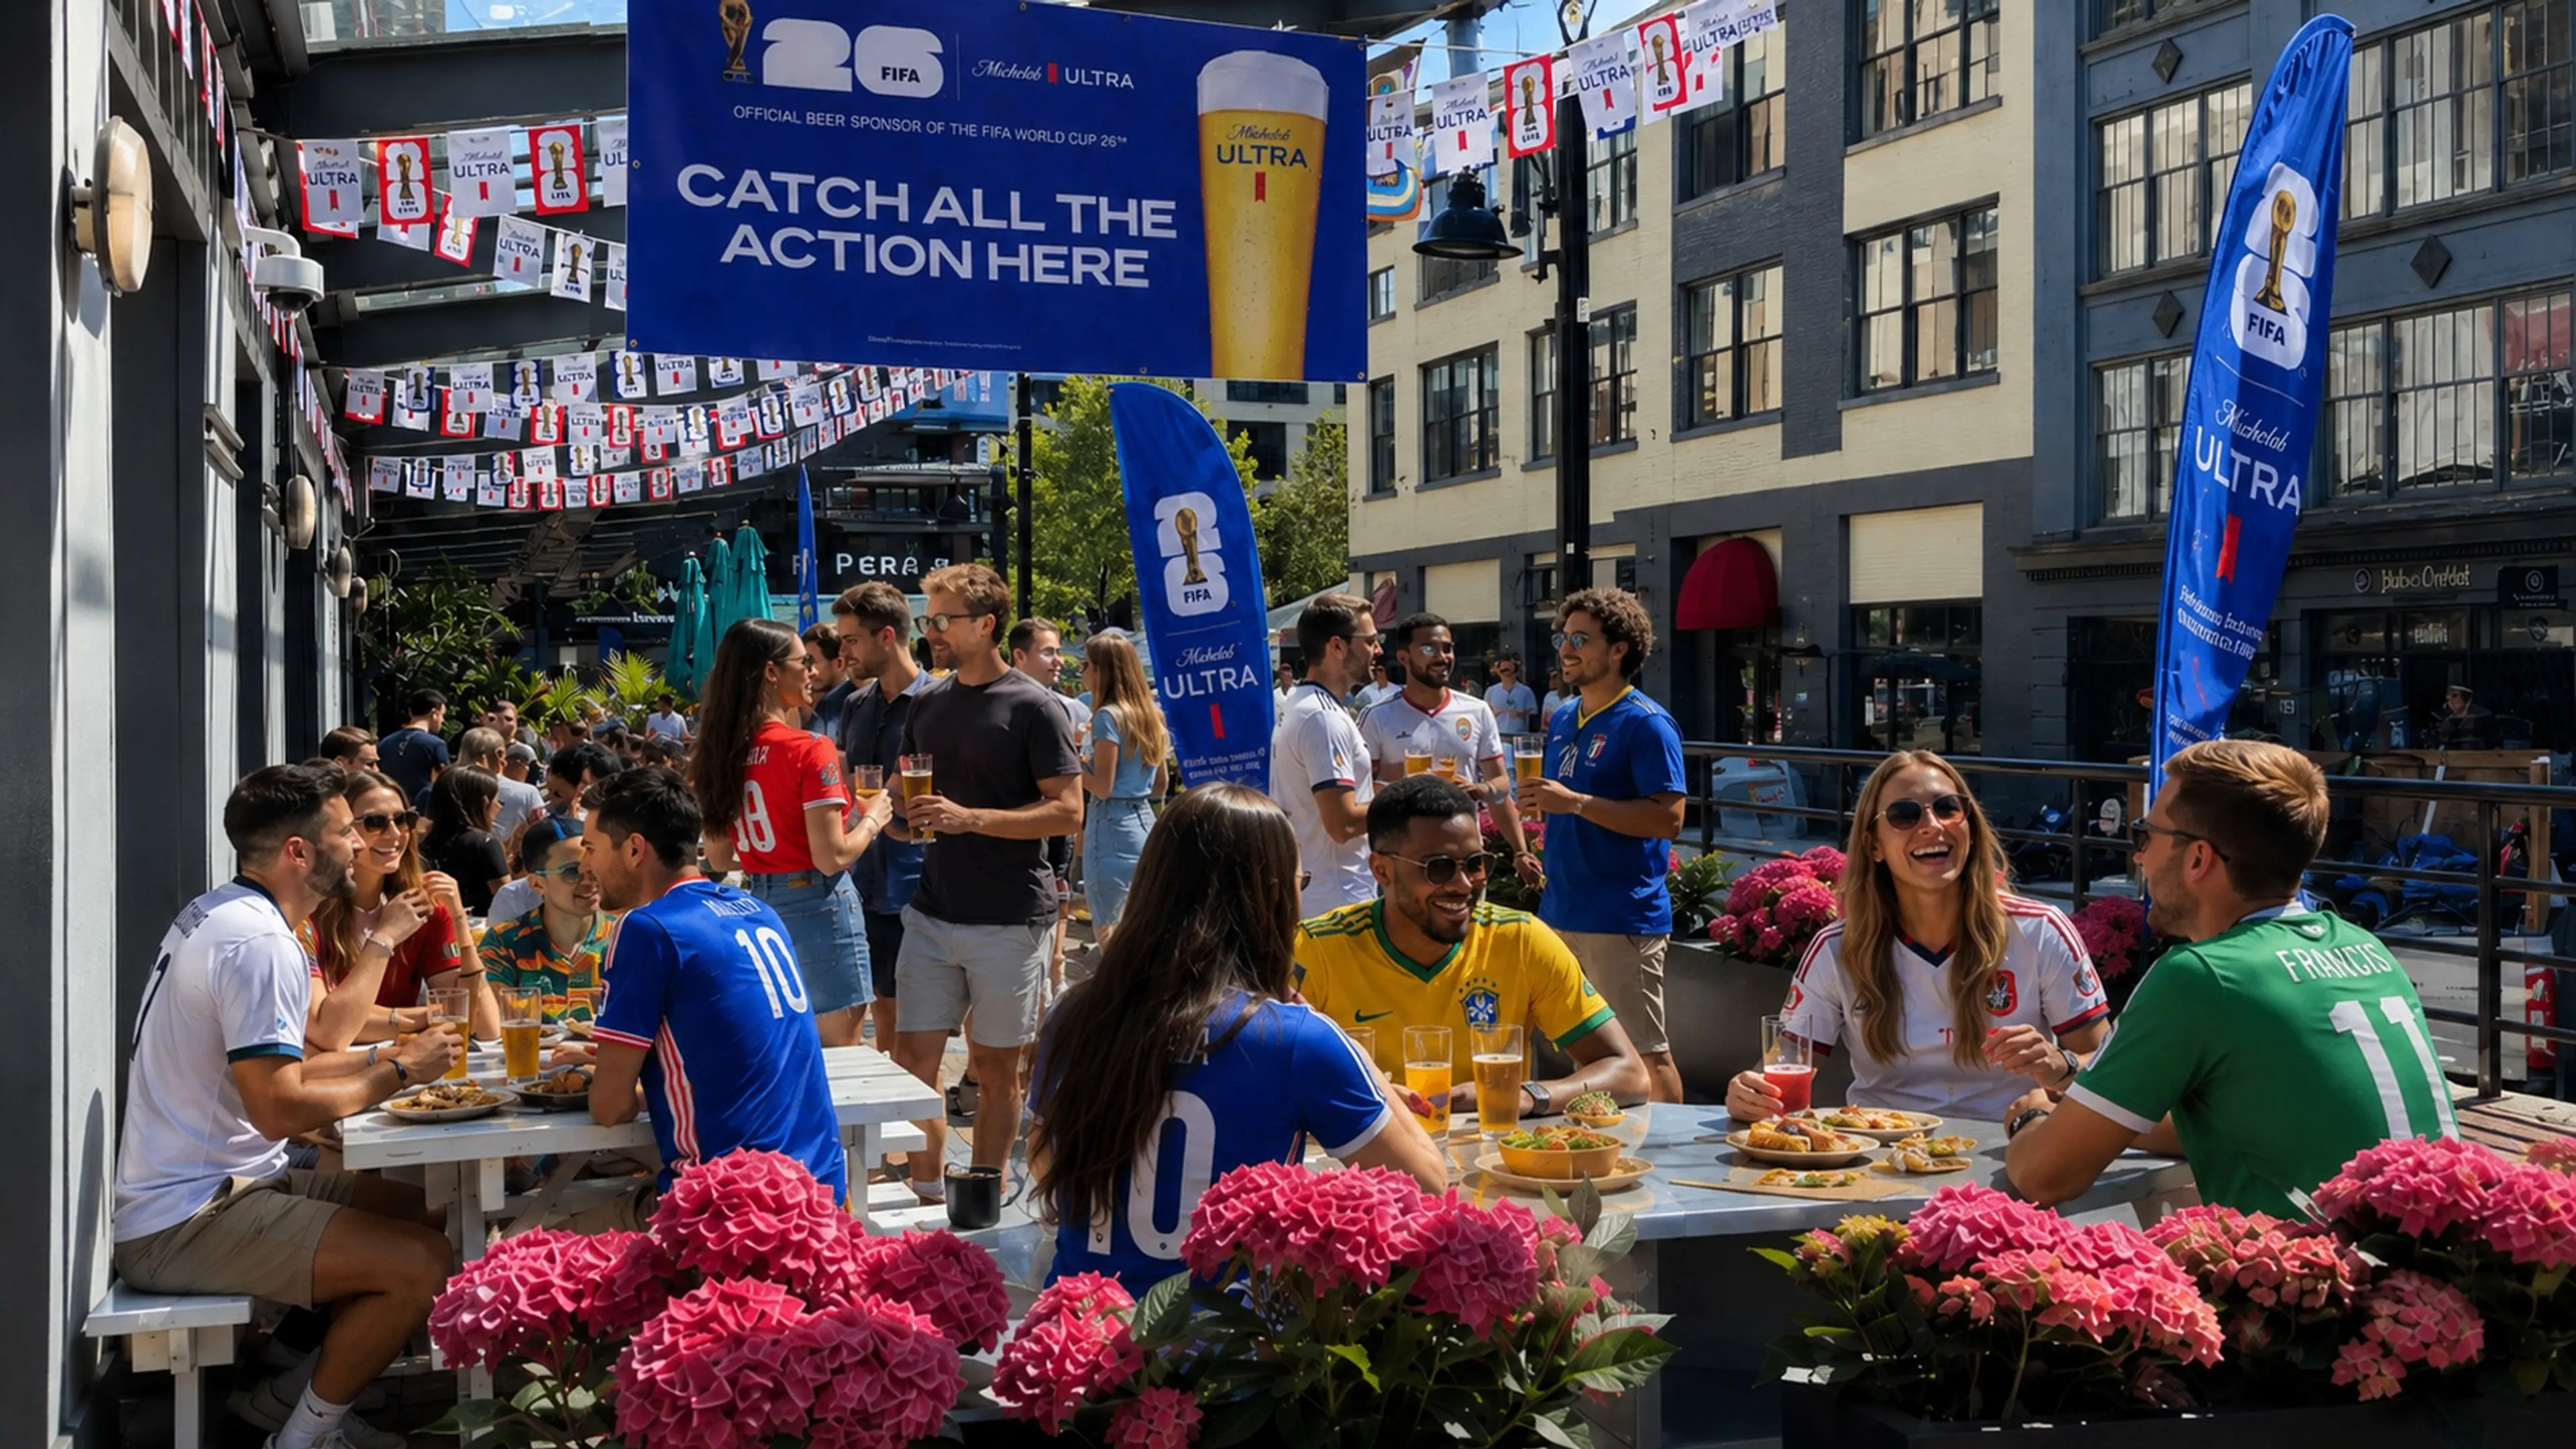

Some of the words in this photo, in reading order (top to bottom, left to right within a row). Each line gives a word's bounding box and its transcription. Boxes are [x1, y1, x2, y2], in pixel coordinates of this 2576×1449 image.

[763, 17, 945, 99] 26
[881, 66, 921, 84] FIFA
[972, 59, 1042, 81] Michelob
[1065, 67, 1135, 89] ULTRA
[1578, 64, 1631, 92] ULTRA
[733, 105, 802, 125] OFFICIAL
[806, 112, 846, 127] BEER
[851, 115, 922, 133] SPONSOR
[926, 122, 945, 135] OF
[950, 122, 977, 138] THE
[982, 125, 1012, 140] FIFA
[1014, 128, 1065, 144] WORLD
[1068, 131, 1097, 146] CUP
[1436, 107, 1489, 129] ULTRA
[453, 162, 511, 178] ULTRA
[1216, 143, 1308, 169] ULTRA
[307, 171, 360, 186] ULTRA
[677, 163, 910, 223] CATCH
[922, 186, 1046, 231] ALL
[1055, 193, 1178, 239] THE
[720, 223, 973, 279] ACTION
[987, 241, 1150, 288] HERE
[2247, 312, 2286, 347] FIFA
[2195, 425, 2301, 517] ULTRA
[1183, 588, 1212, 604] FIFA
[1163, 664, 1259, 699] ULTRA
[735, 926, 808, 1019] 10
[2275, 943, 2392, 983] FRANCIS
[2328, 996, 2461, 1141] 11
